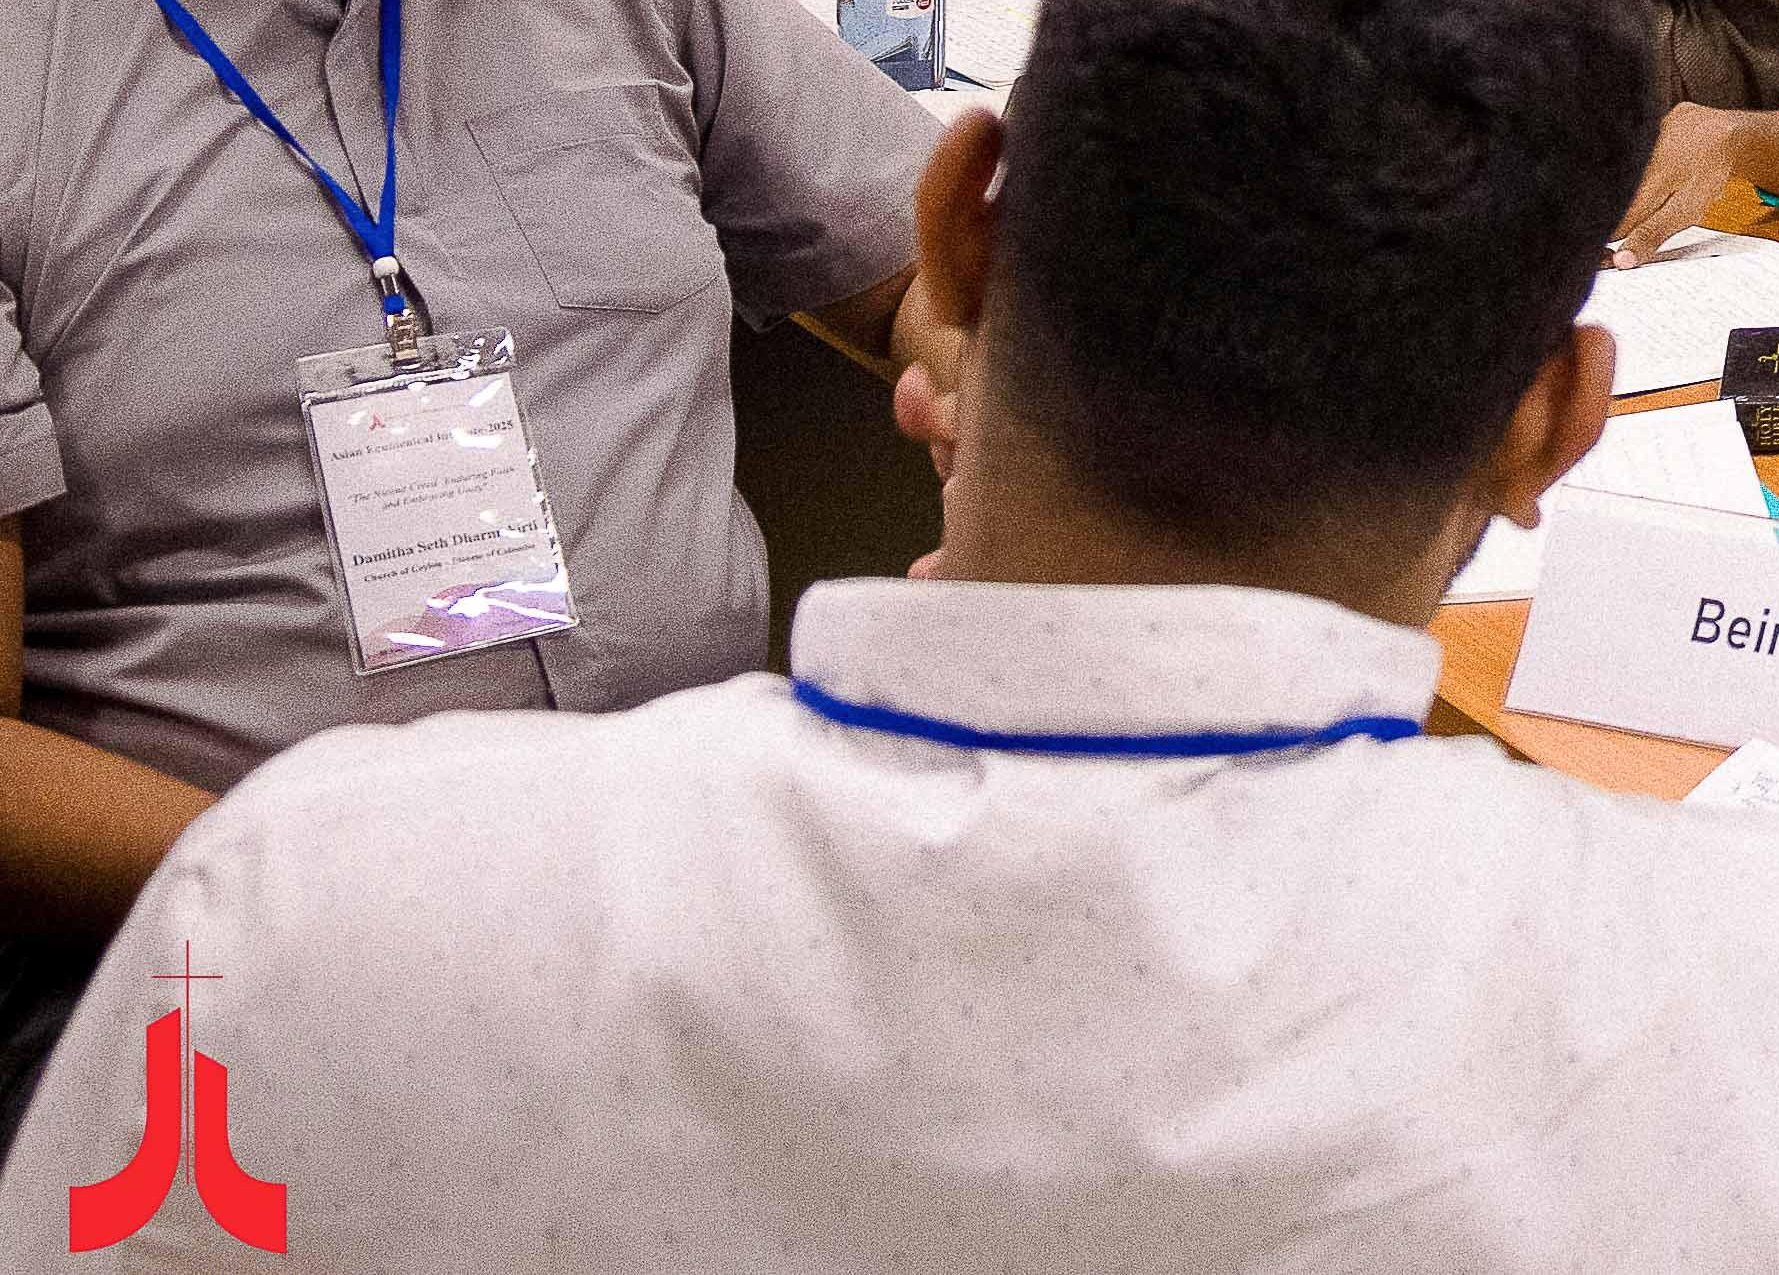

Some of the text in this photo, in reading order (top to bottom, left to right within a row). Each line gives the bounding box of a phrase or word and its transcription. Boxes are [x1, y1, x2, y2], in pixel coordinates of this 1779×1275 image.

[1760, 405, 1771, 446] HOLY
[353, 545, 415, 567] Damitha
[417, 537, 449, 554] Seth
